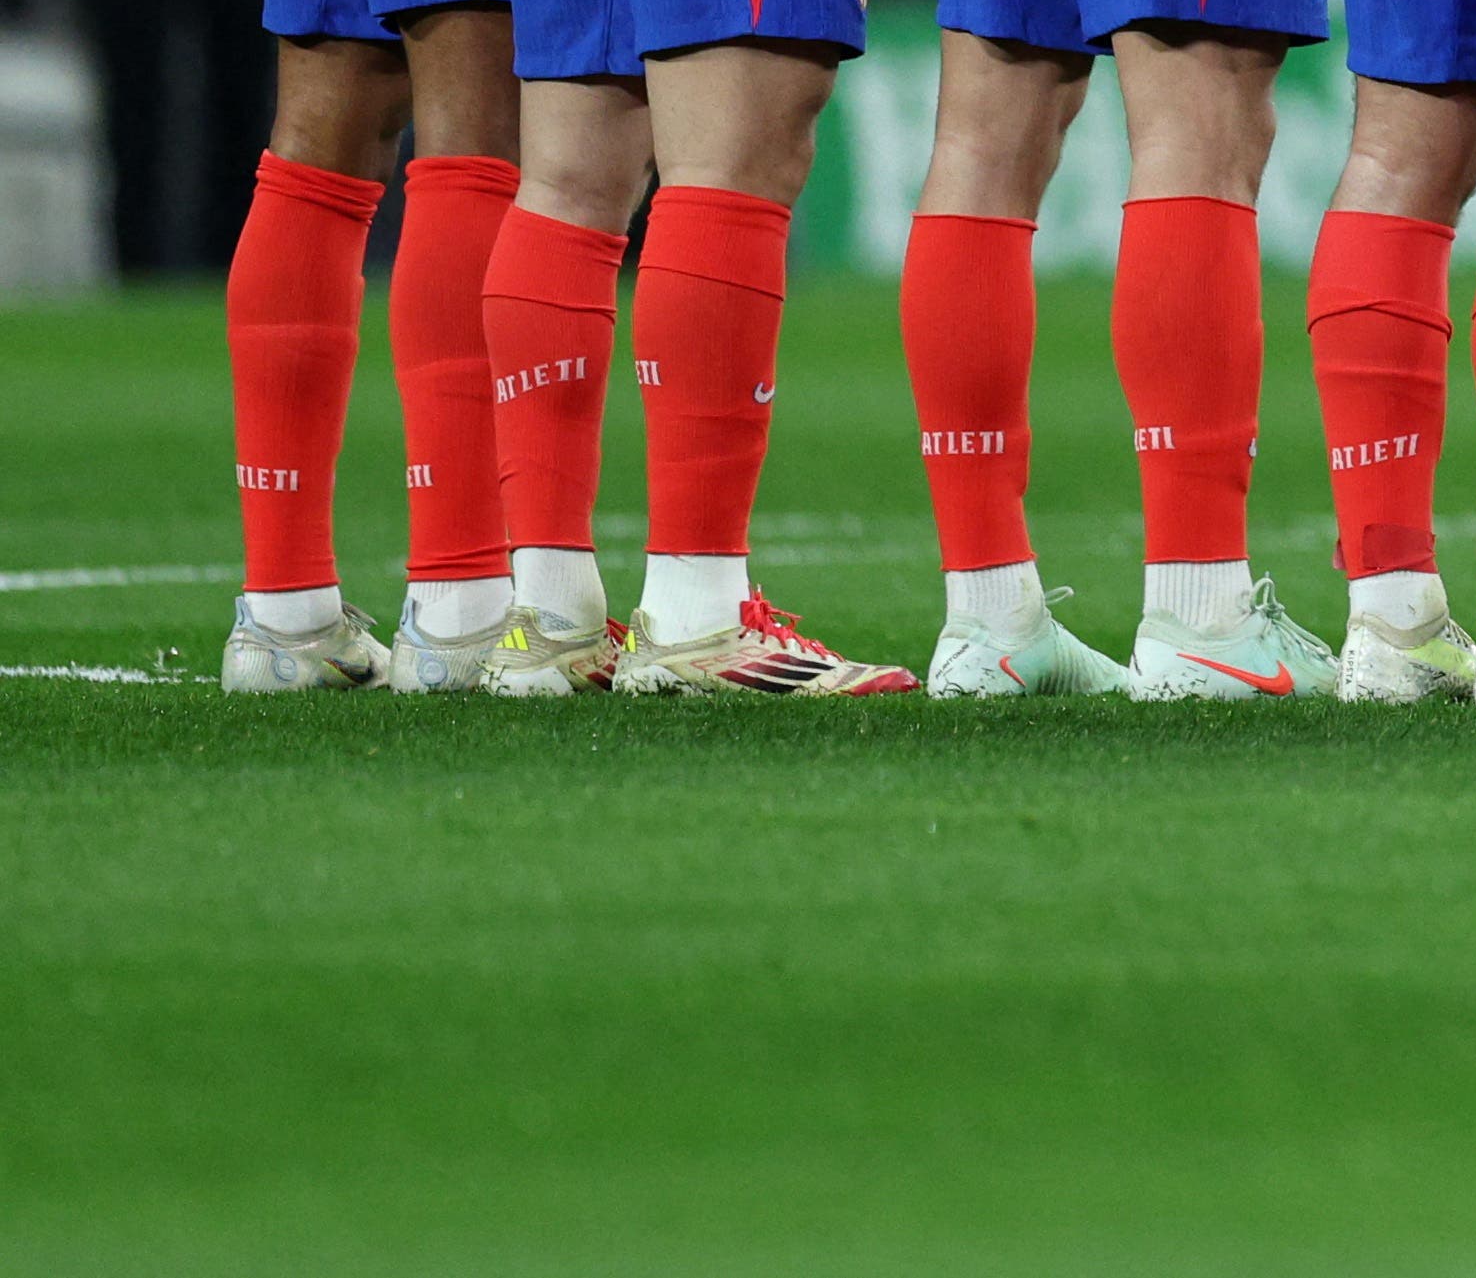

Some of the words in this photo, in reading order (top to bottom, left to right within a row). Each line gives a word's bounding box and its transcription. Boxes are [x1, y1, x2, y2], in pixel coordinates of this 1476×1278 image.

[496, 356, 588, 404] ATLETI
[921, 429, 1005, 458] ATLETI
[1331, 433, 1420, 471] ATLETI
[235, 463, 299, 492] TLETI
